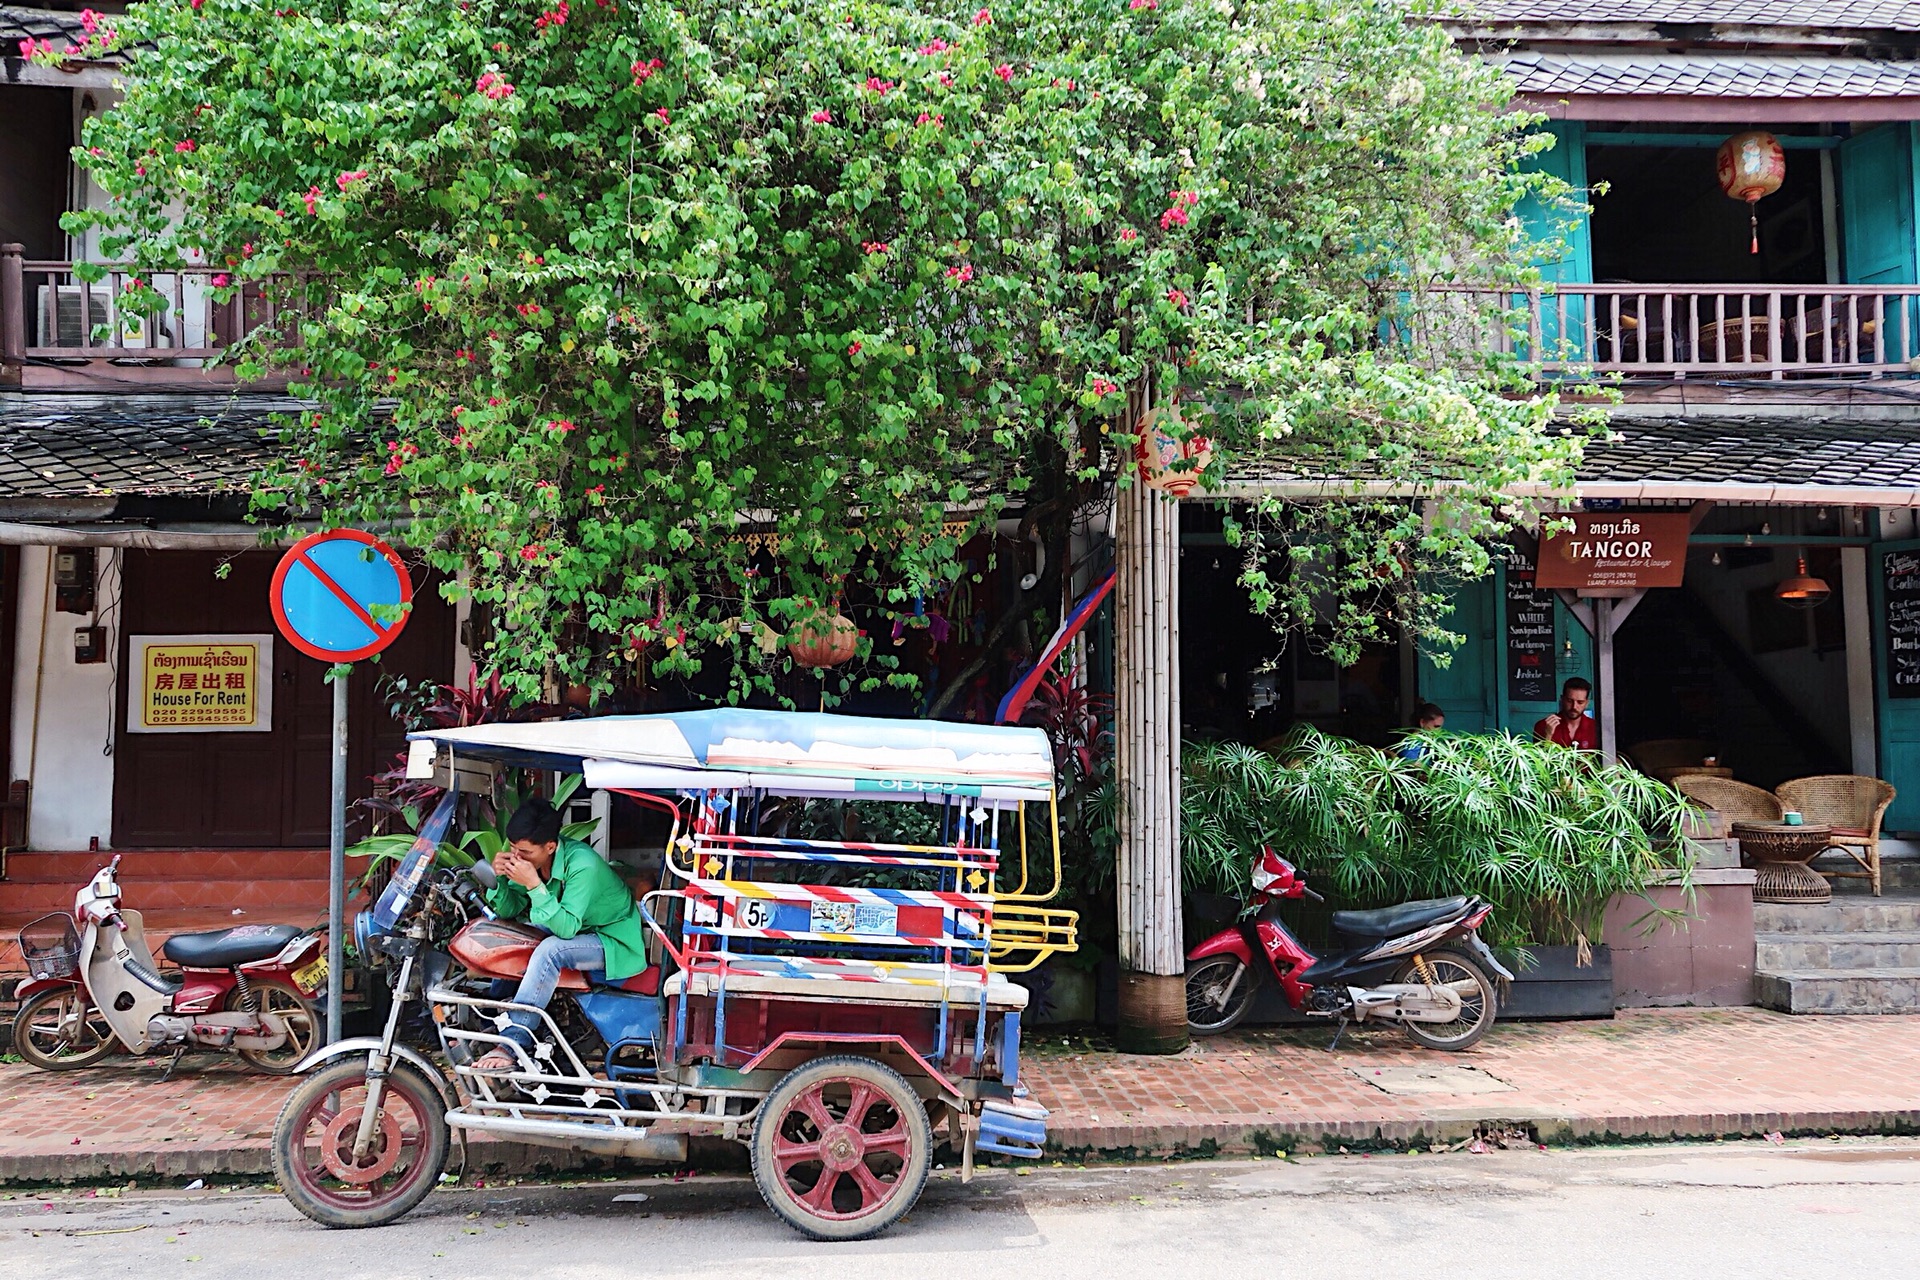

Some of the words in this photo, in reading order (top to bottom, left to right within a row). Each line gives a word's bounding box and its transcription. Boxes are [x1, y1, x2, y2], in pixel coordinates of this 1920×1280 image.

[1570, 541, 1653, 558] TANGOR
[1517, 613, 1546, 623] WHITE
[154, 672, 246, 690] 房屋出租
[153, 692, 191, 706] House
[194, 691, 214, 705] For
[217, 691, 246, 705] Rent
